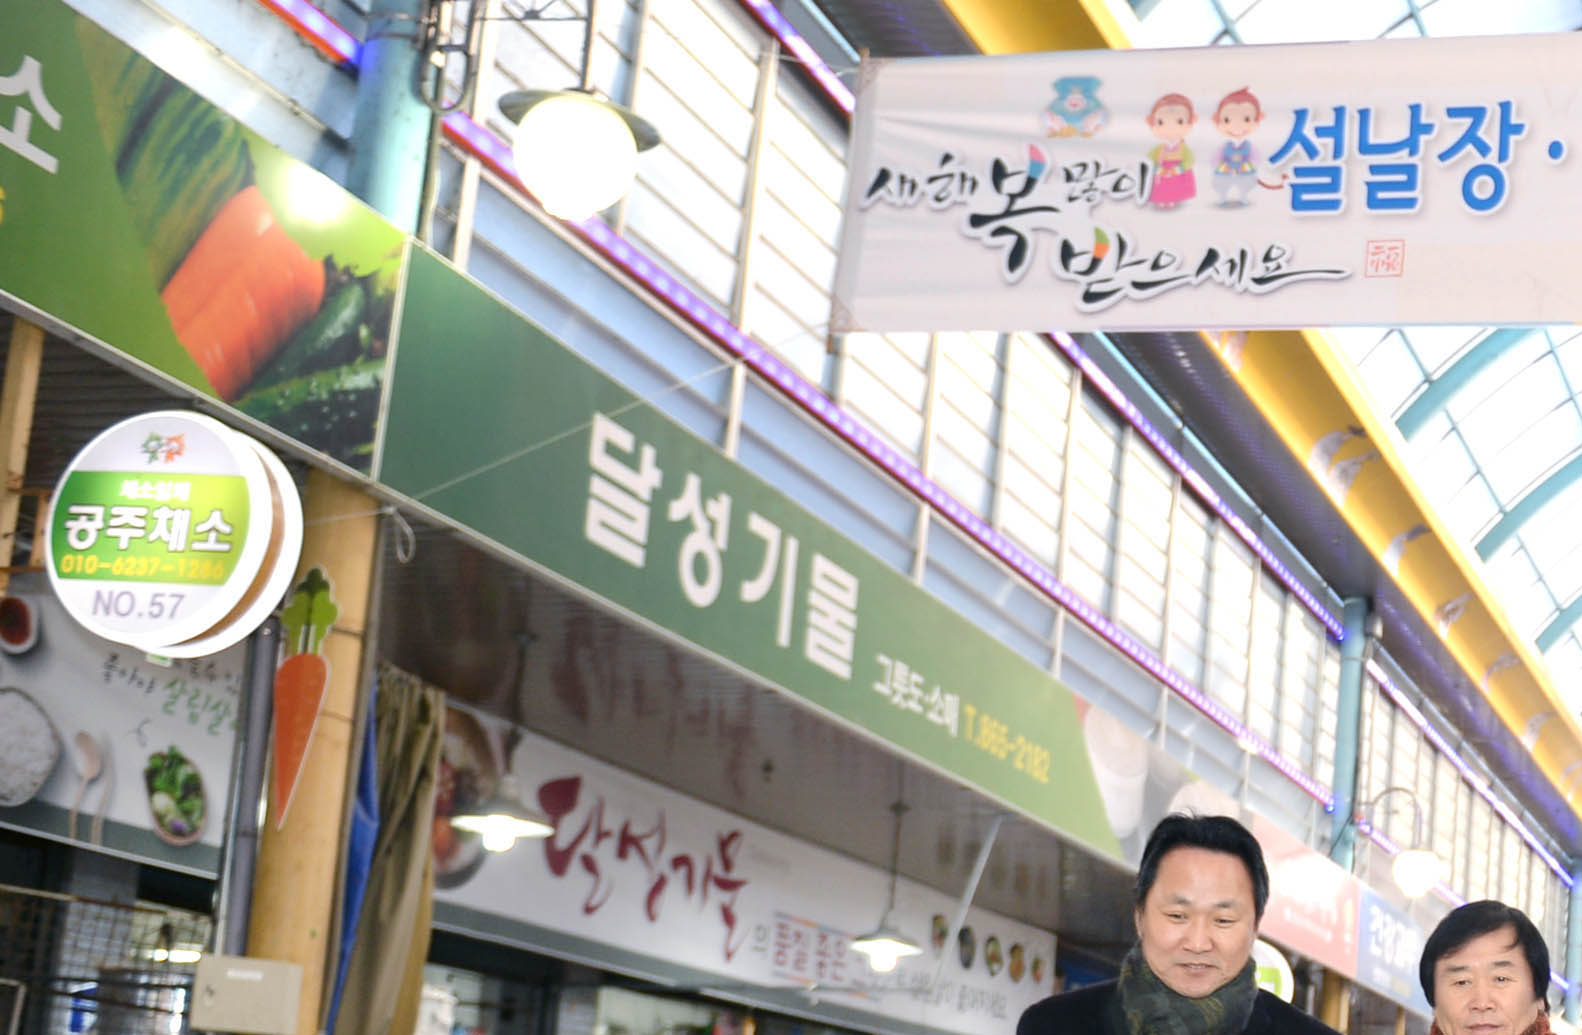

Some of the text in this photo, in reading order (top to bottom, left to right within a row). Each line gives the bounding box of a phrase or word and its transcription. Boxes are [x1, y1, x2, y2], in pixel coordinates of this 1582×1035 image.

[863, 143, 1153, 271] 새해 복 많이
[1059, 228, 1352, 305] 받으세요
[64, 503, 233, 553] 공주채소
[584, 411, 859, 682] 달성기물
[91, 589, 186, 620] NO.57
